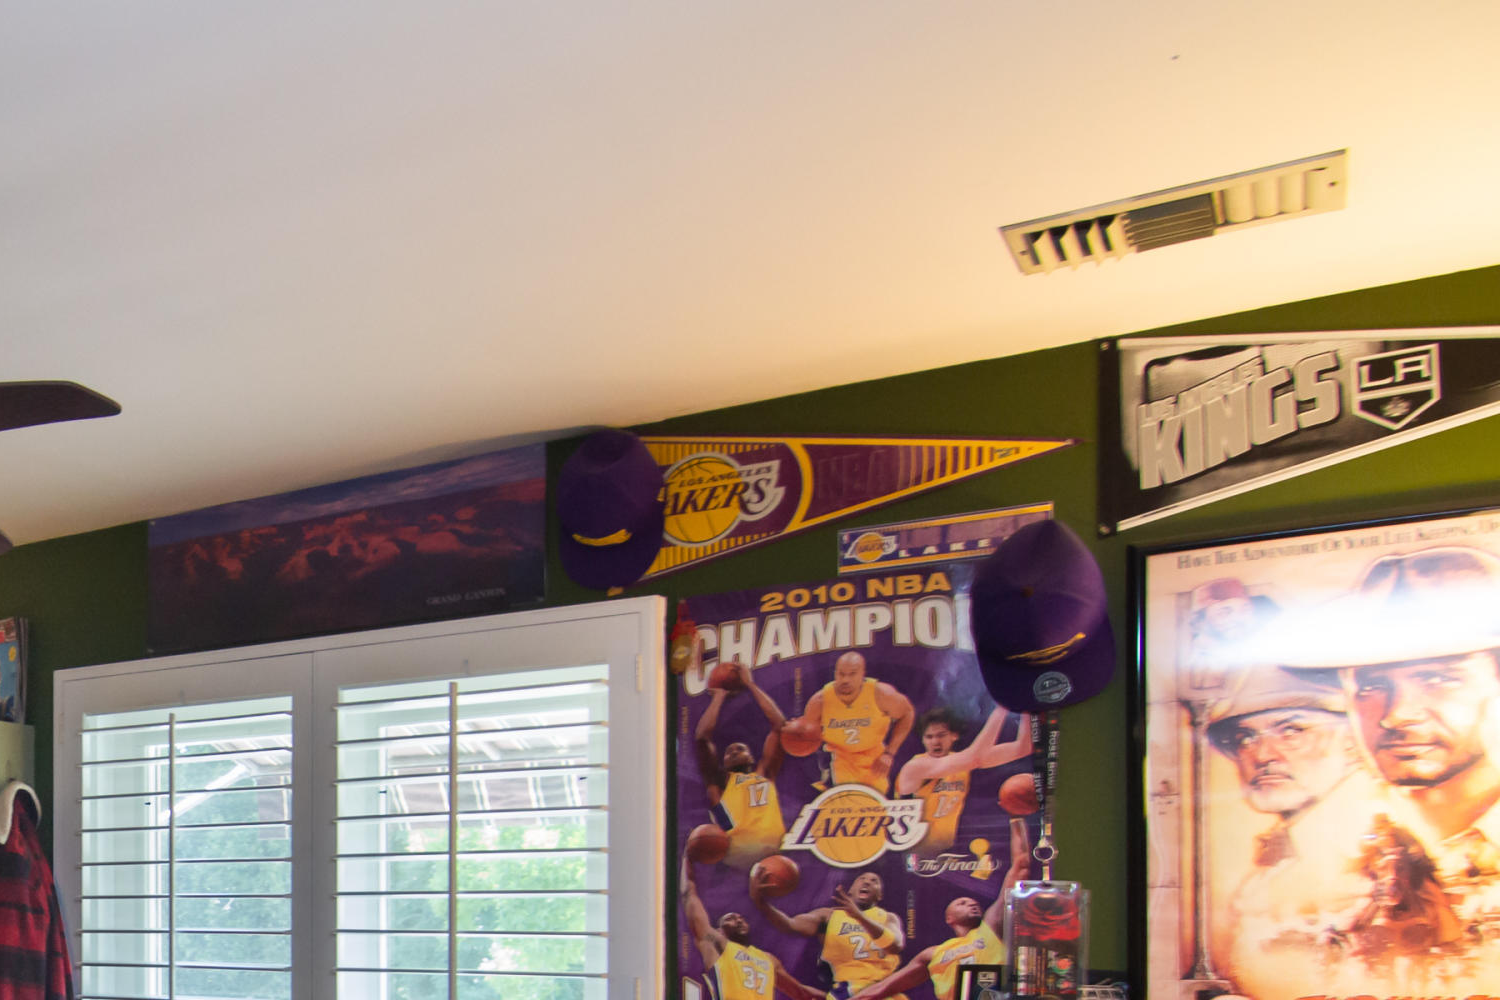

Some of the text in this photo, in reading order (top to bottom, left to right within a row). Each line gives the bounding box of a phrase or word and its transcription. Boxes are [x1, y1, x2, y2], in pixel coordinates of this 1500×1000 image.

[1358, 354, 1432, 388] LA
[1139, 350, 1342, 490] KINGS
[711, 465, 774, 485] ANGELES
[657, 477, 773, 517] AKERS
[898, 535, 1012, 558] LAKE
[760, 571, 952, 612] 2010 NBA
[844, 729, 861, 745] 2
[748, 781, 770, 808] 17
[795, 807, 913, 846] LAKERS
[918, 857, 940, 873] The
[742, 966, 769, 995] 37
